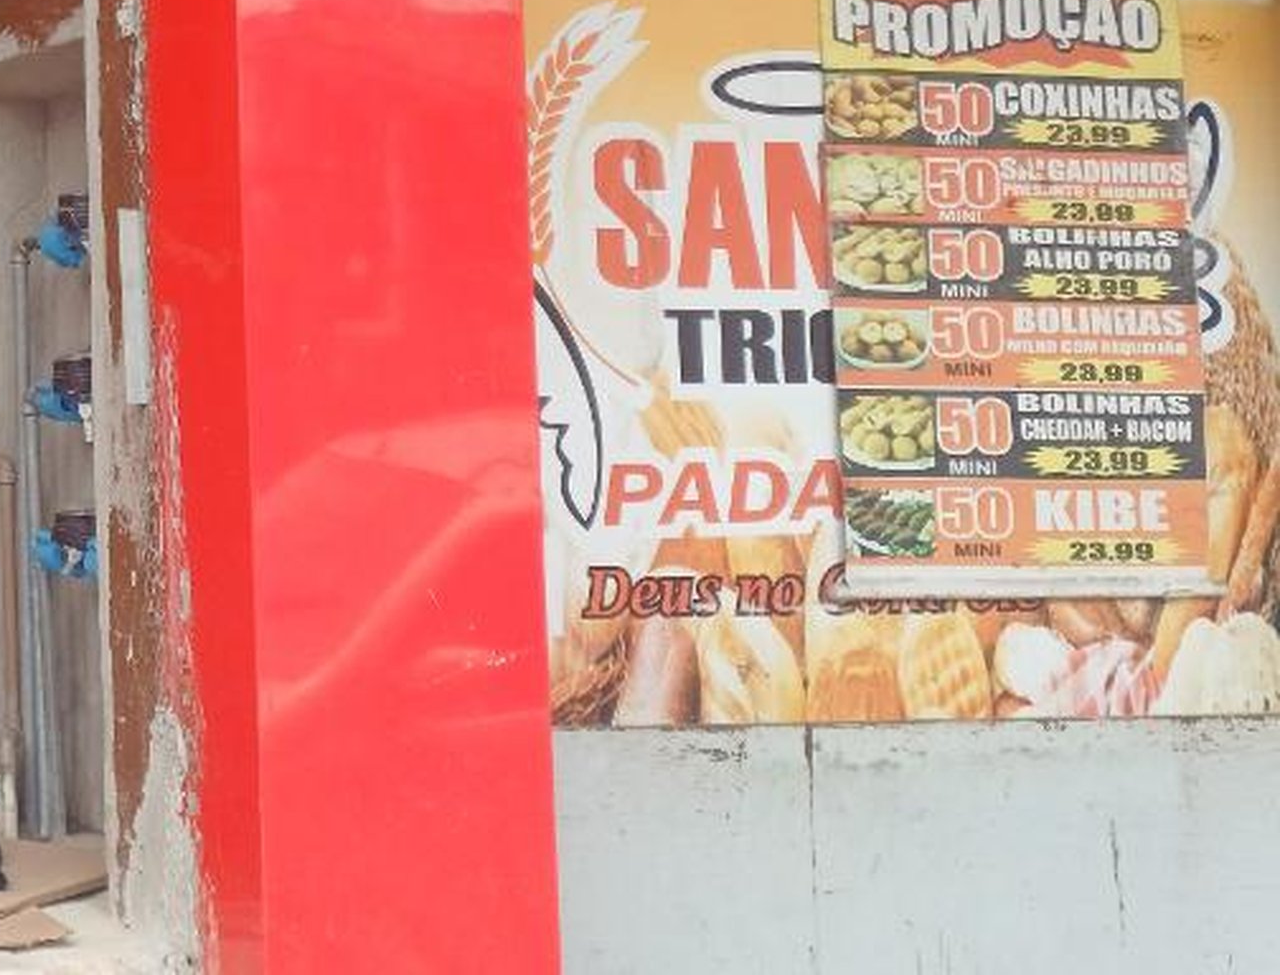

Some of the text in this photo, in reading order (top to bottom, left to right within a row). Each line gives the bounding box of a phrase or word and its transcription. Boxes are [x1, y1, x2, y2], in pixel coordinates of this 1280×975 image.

[919, 81, 1180, 135] 50 COXINHAS
[937, 135, 980, 147] MINI
[924, 158, 1001, 209] 50
[594, 139, 829, 289] SAN
[939, 209, 984, 223] MINI
[927, 227, 1180, 280] 50 BOLINHAS
[1023, 249, 1172, 270] ALHO PORÓ
[941, 283, 988, 299] MINI
[929, 306, 1186, 358] 50 BOLINHAS
[945, 361, 992, 378] MINI
[937, 393, 1191, 455] 50 BOLINHAS
[1020, 419, 1108, 442] CHEDDAR
[1127, 420, 1192, 442] BACON
[605, 459, 844, 526] PADA
[949, 461, 997, 475] MINI
[937, 488, 1170, 539] 50 KIBE
[954, 544, 1003, 559] MINI
[582, 566, 722, 618] Deus
[736, 573, 804, 615] no
